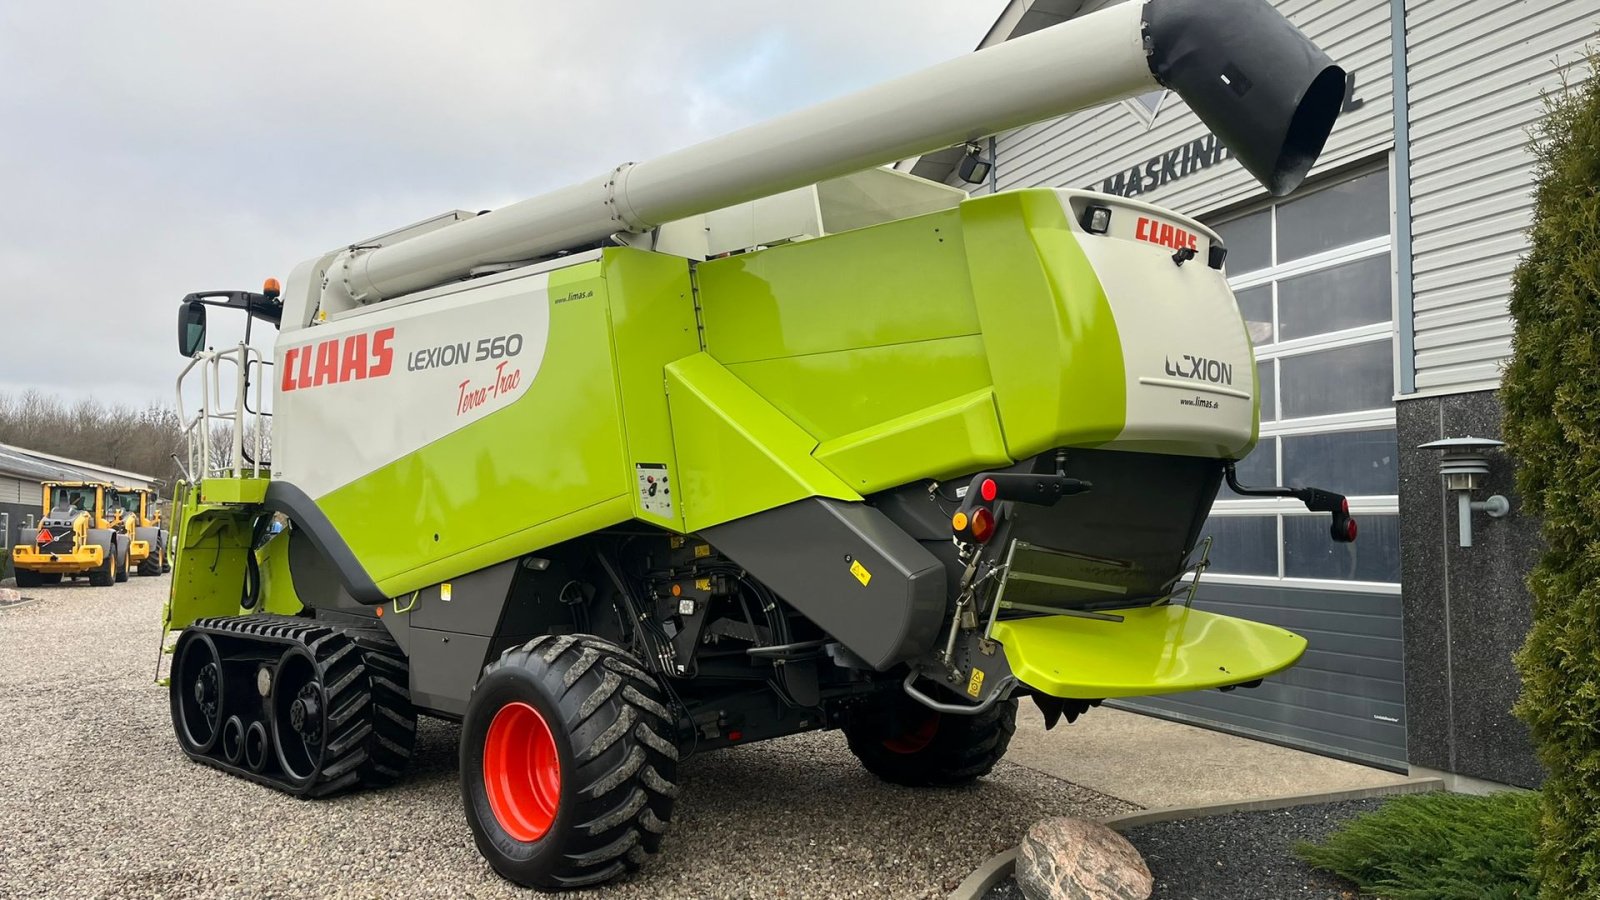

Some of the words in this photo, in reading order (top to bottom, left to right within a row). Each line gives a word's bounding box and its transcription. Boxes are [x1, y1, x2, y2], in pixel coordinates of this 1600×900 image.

[1135, 217, 1197, 250] CLAAS
[281, 327, 395, 391] CLAAS
[407, 341, 470, 372] LEXION
[475, 333, 523, 362] 560
[457, 360, 521, 416] Terra-Trac
[1180, 396, 1219, 409] www.limas.dk
